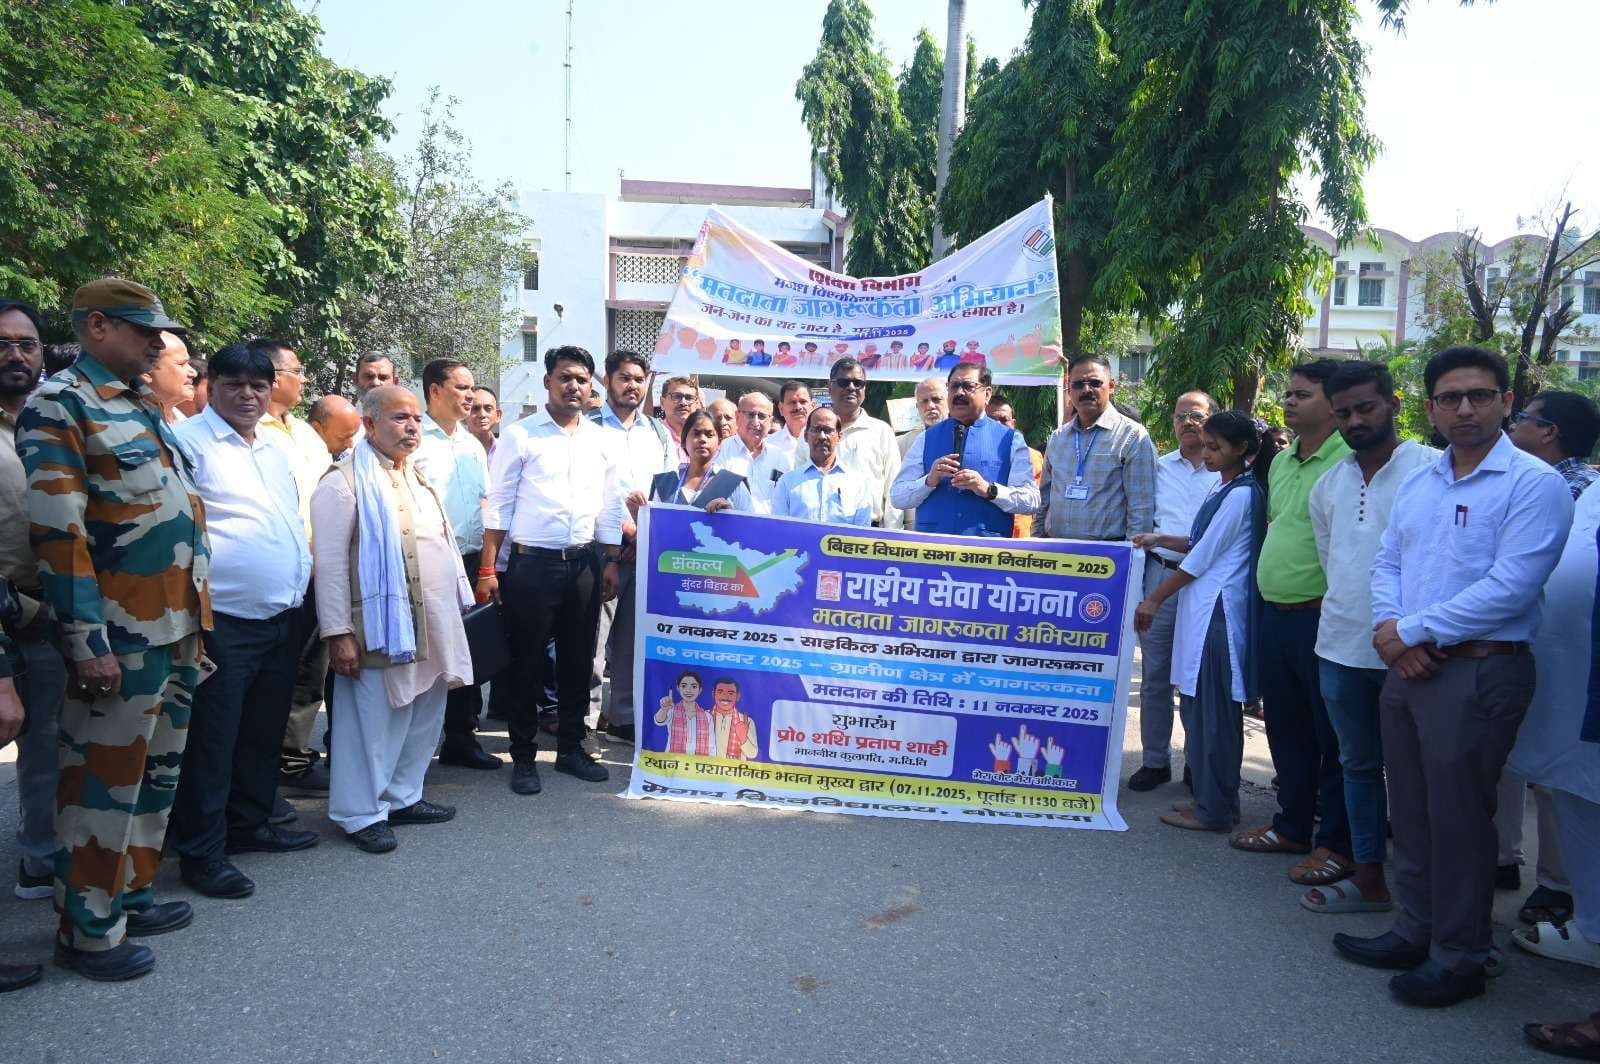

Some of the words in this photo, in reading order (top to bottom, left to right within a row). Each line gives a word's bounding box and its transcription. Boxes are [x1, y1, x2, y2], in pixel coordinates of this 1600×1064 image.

[793, 296, 922, 319] जागरूकता
[962, 303, 1003, 318] हमारा
[754, 315, 773, 327] का
[671, 553, 725, 572] संकल्प
[827, 537, 869, 555] बिहार
[872, 541, 919, 559] विधान
[923, 549, 956, 562] सभा
[959, 552, 993, 565] आम
[997, 551, 1058, 570] निर्वाचन
[1077, 562, 1109, 575] 2025
[681, 577, 702, 591] सुंदर
[704, 578, 729, 591] बिहार
[730, 583, 744, 592] का
[845, 567, 924, 607] राष्ट्रीय
[927, 571, 983, 610] सेवा
[986, 577, 1078, 618] योजना
[812, 608, 894, 631] मतदाता
[899, 615, 1010, 641] जागरूकता
[1014, 621, 1109, 648] अभियान
[656, 622, 674, 634] 07
[678, 624, 740, 641] नवम्बर
[742, 631, 778, 644] 2025
[800, 636, 880, 656] साइकिल
[882, 642, 957, 661] अभियान
[961, 651, 998, 664] द्वारा
[1002, 654, 1104, 673] जागरूकता
[656, 645, 677, 657] 08
[681, 648, 756, 665] नवम्बर
[760, 655, 801, 669] 2025
[830, 661, 904, 680] ग्रामीण
[909, 667, 946, 684] क्षेत्र
[951, 671, 976, 685] में
[978, 675, 1102, 697] जागरूकता
[812, 683, 878, 701] मतदान
[882, 687, 909, 703] की
[912, 689, 955, 708] तिथि
[973, 700, 988, 712] 11
[995, 701, 1060, 717] नवम्बर
[1062, 706, 1099, 721] 2025
[832, 713, 897, 731] शुभारंभ
[794, 747, 837, 759] माननीय
[811, 730, 851, 747] शशि
[855, 736, 902, 751] प्रताप
[906, 740, 950, 756] शाही
[641, 780, 727, 798] मगध
[643, 756, 680, 770] स्थान
[695, 762, 773, 781] प्रशासनिक
[775, 769, 813, 785] भवन
[816, 775, 854, 791] मुख्य
[859, 779, 886, 792] द्वार
[1022, 795, 1057, 807] 11:30
